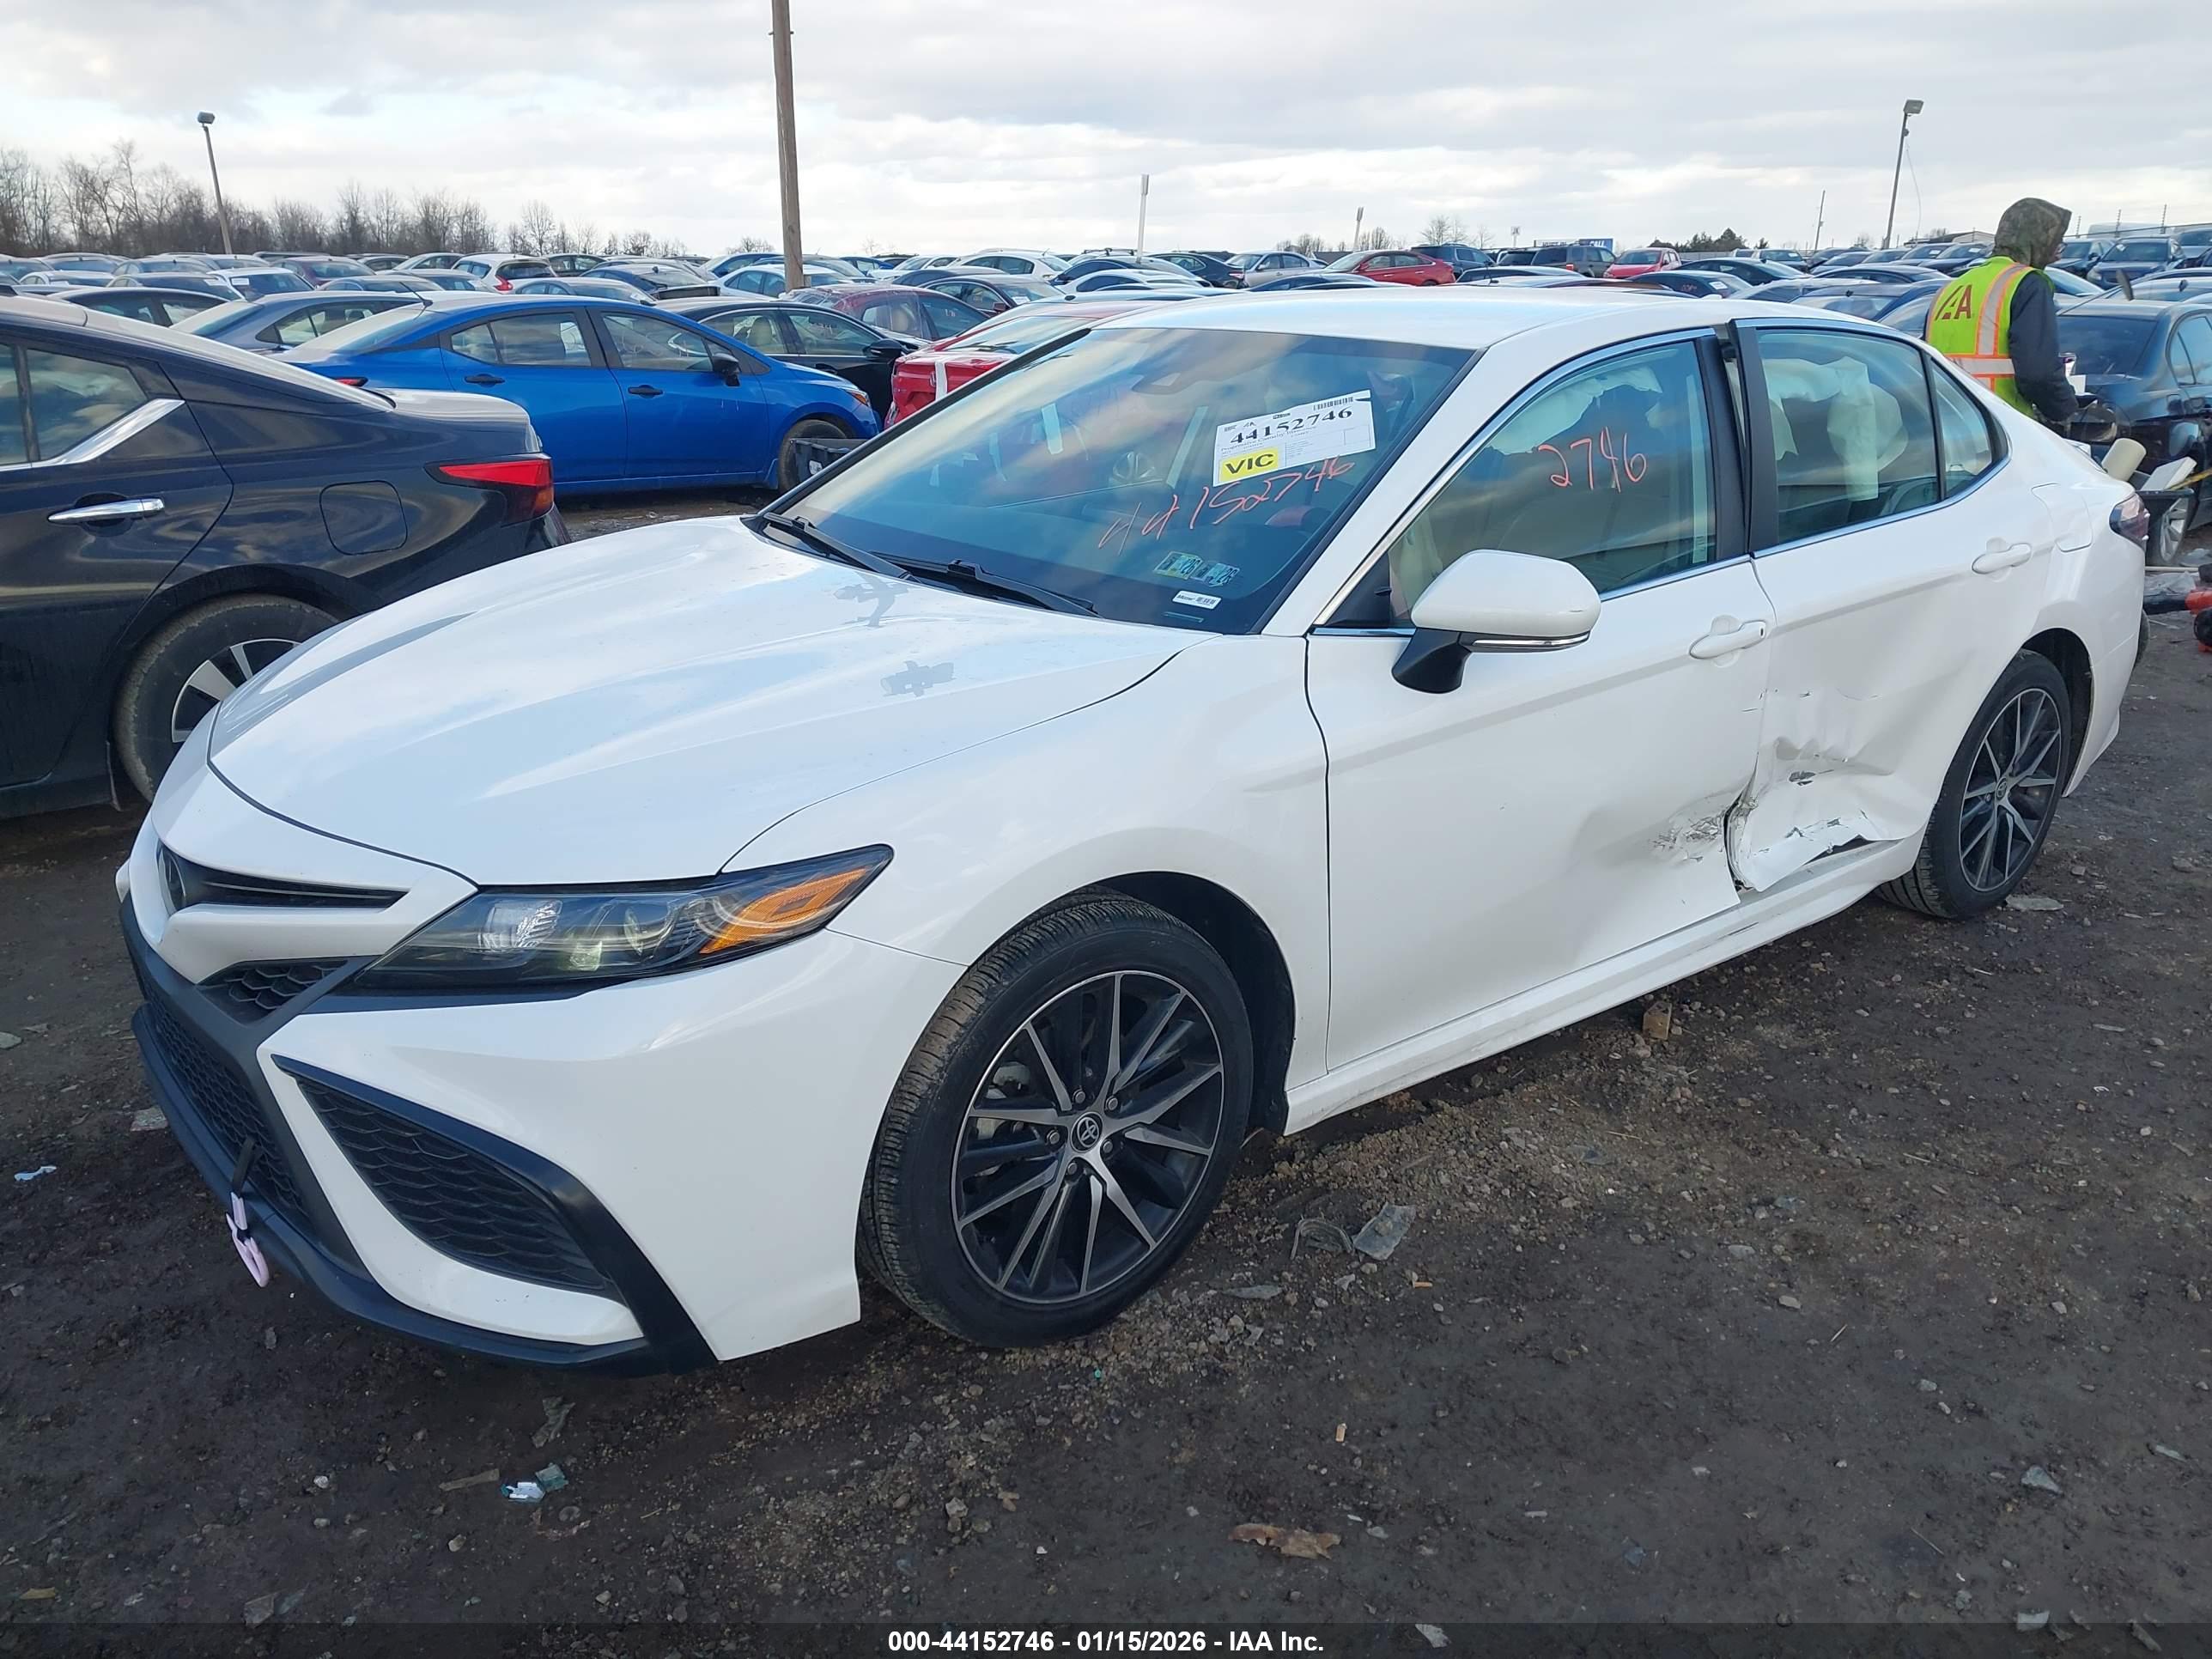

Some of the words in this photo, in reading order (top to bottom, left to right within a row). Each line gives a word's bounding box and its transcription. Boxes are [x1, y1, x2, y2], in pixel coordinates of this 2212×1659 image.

[1230, 406, 1353, 444] 44152746
[1225, 453, 1274, 475] VIC
[1538, 426, 1647, 493] 2746
